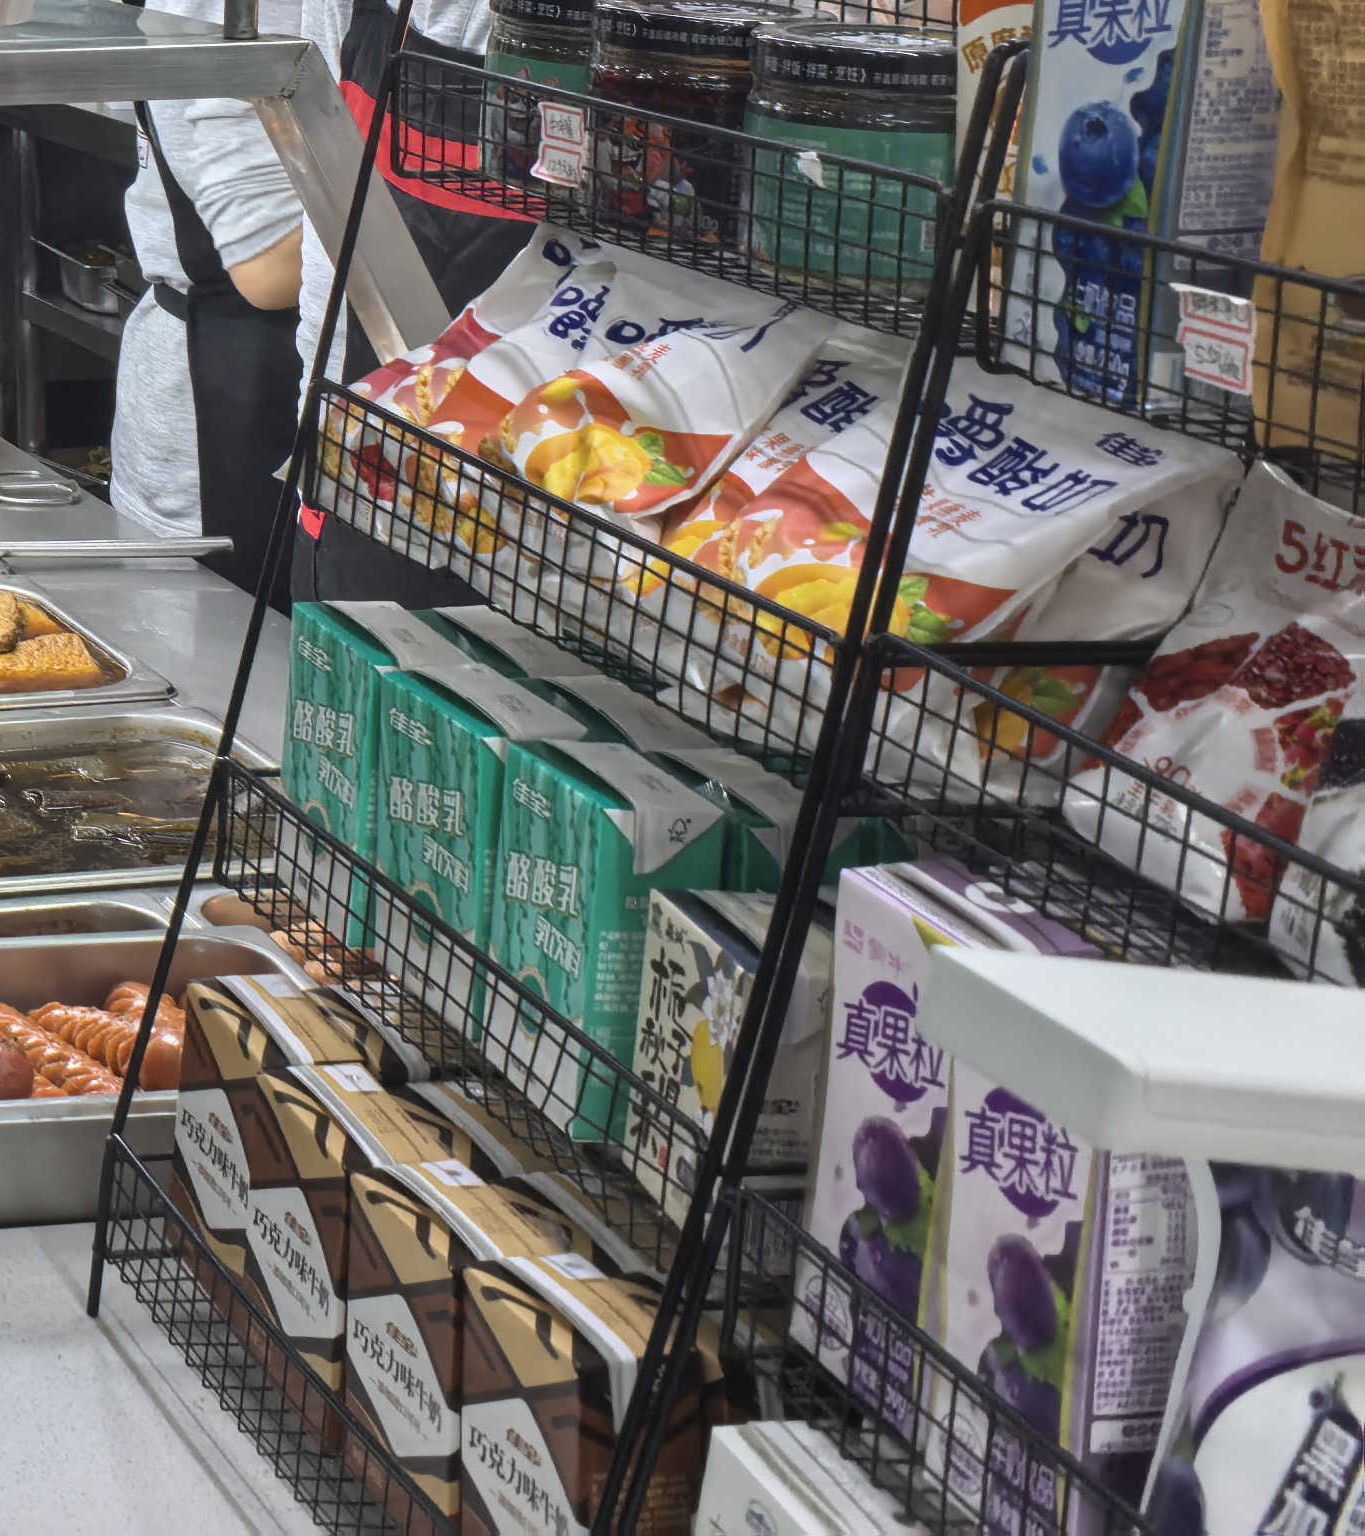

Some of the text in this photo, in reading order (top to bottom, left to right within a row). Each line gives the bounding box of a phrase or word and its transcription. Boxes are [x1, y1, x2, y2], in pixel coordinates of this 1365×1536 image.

[293, 699, 355, 758] 酪酸乳
[389, 776, 464, 836] 酪酸乳
[505, 850, 579, 919] 酪酸乳
[836, 999, 946, 1089] 真果粒
[180, 1109, 249, 1210] 巧克力味牛奶
[960, 1104, 1078, 1201] 真果粒
[253, 1206, 330, 1317] 巧克力味牛奶
[353, 1317, 442, 1434] 巧克力味牛奶
[469, 1424, 569, 1536] 巧克力味牛奶
